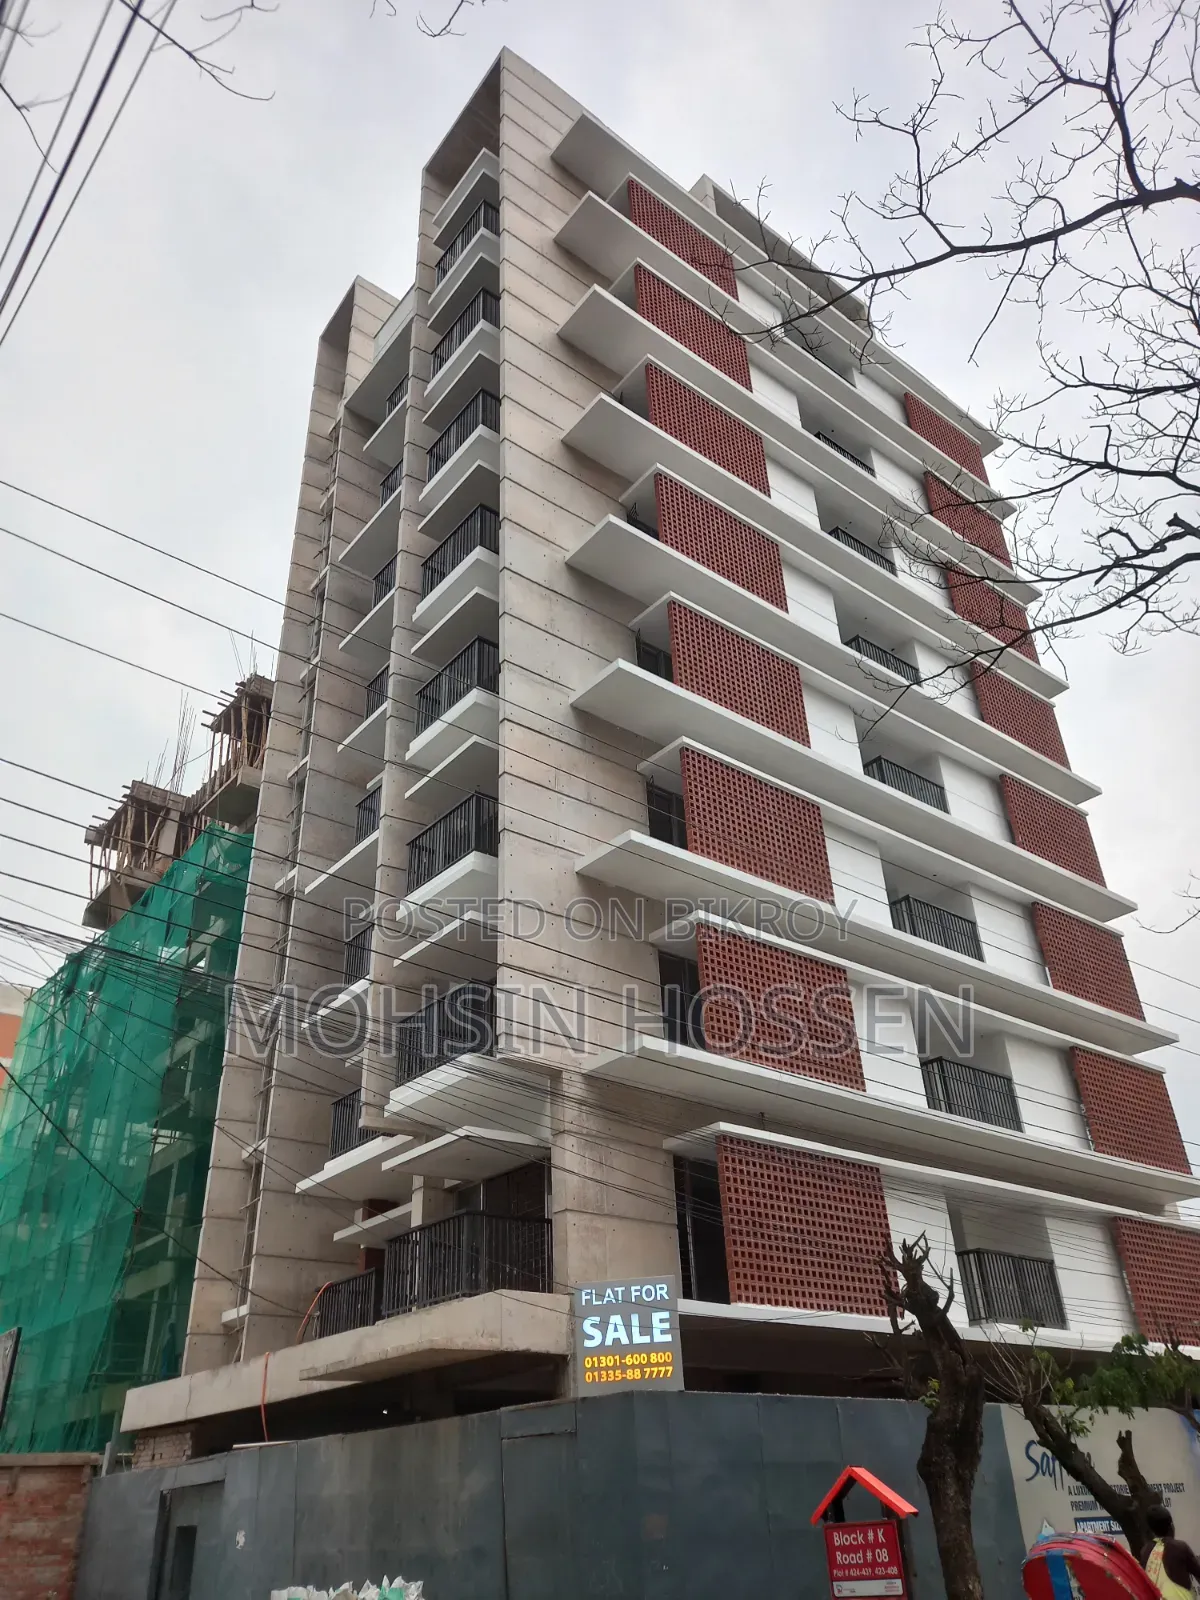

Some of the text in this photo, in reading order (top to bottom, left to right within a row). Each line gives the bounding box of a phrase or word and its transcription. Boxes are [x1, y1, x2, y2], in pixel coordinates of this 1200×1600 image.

[582, 1284, 669, 1305] FLAT FOR
[583, 1311, 672, 1348] SALE
[585, 1352, 672, 1368] 01301-600 800
[585, 1366, 673, 1383] 01335-88 7777
[833, 1529, 886, 1546] Block # K
[836, 1548, 889, 1564] Road # 08
